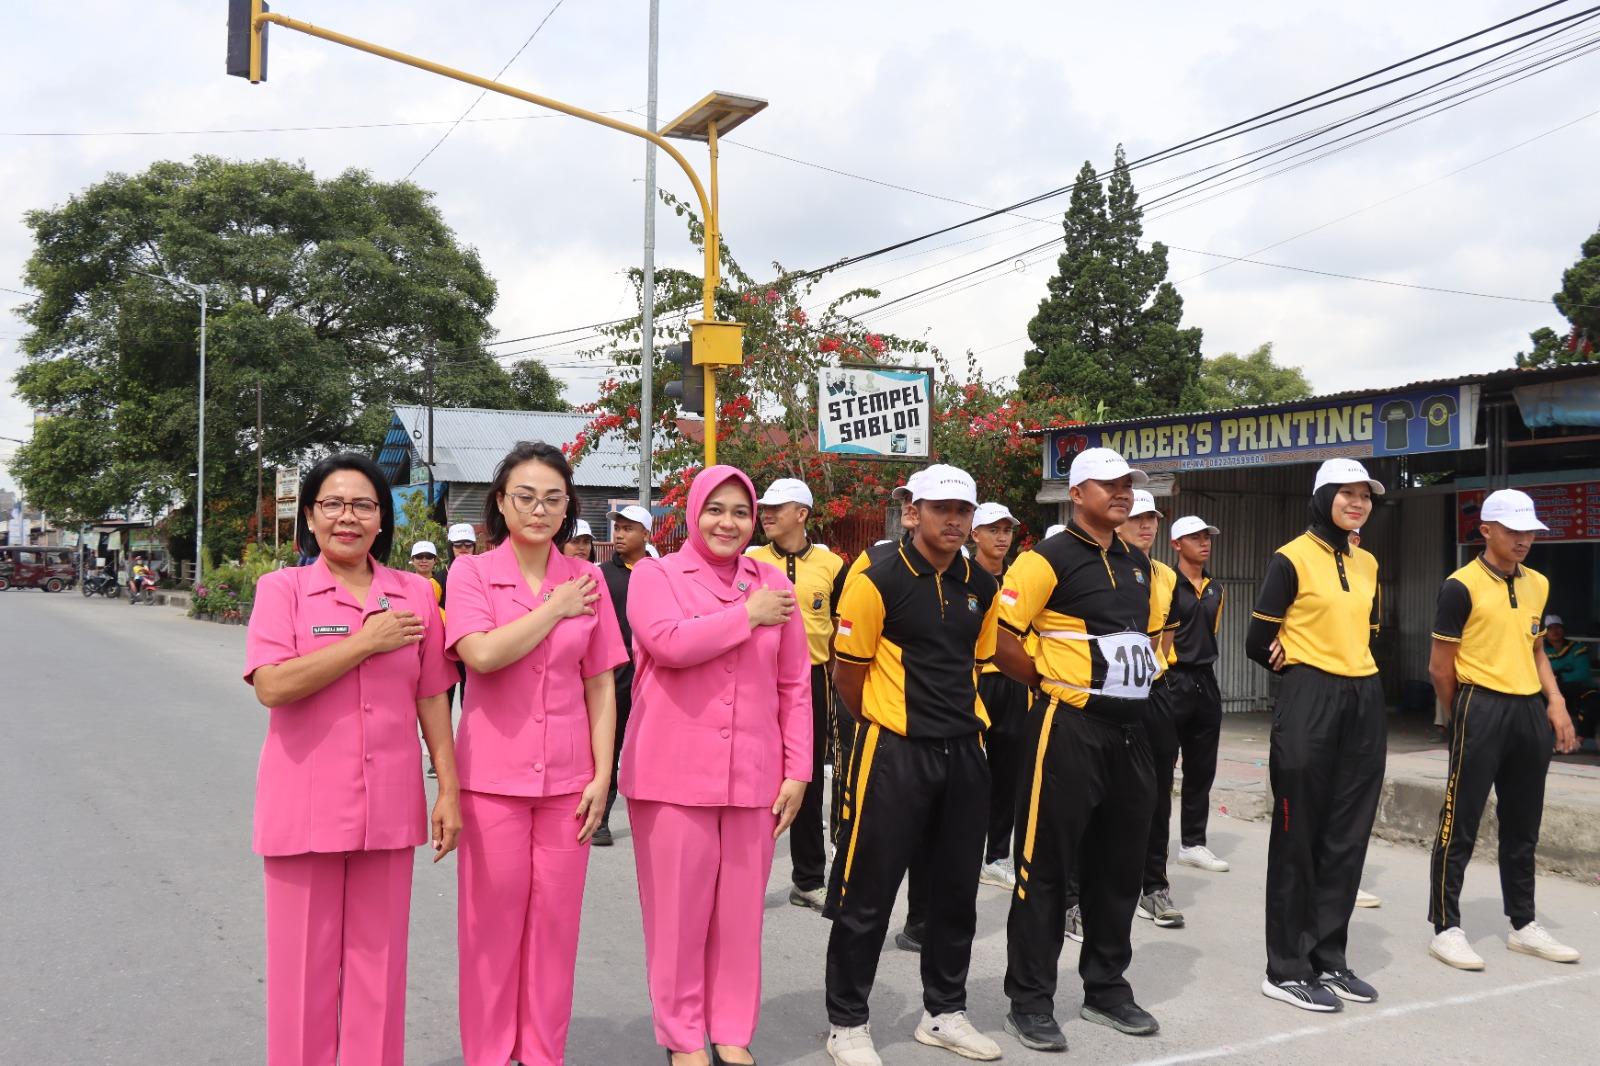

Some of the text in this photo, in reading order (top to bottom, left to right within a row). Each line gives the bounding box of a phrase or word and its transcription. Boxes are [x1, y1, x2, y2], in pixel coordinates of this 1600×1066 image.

[828, 385, 924, 422] STEMPEL
[839, 407, 920, 443] SABLON
[1101, 403, 1373, 460] MABER'S PRINTING
[1114, 644, 1156, 687] 109
